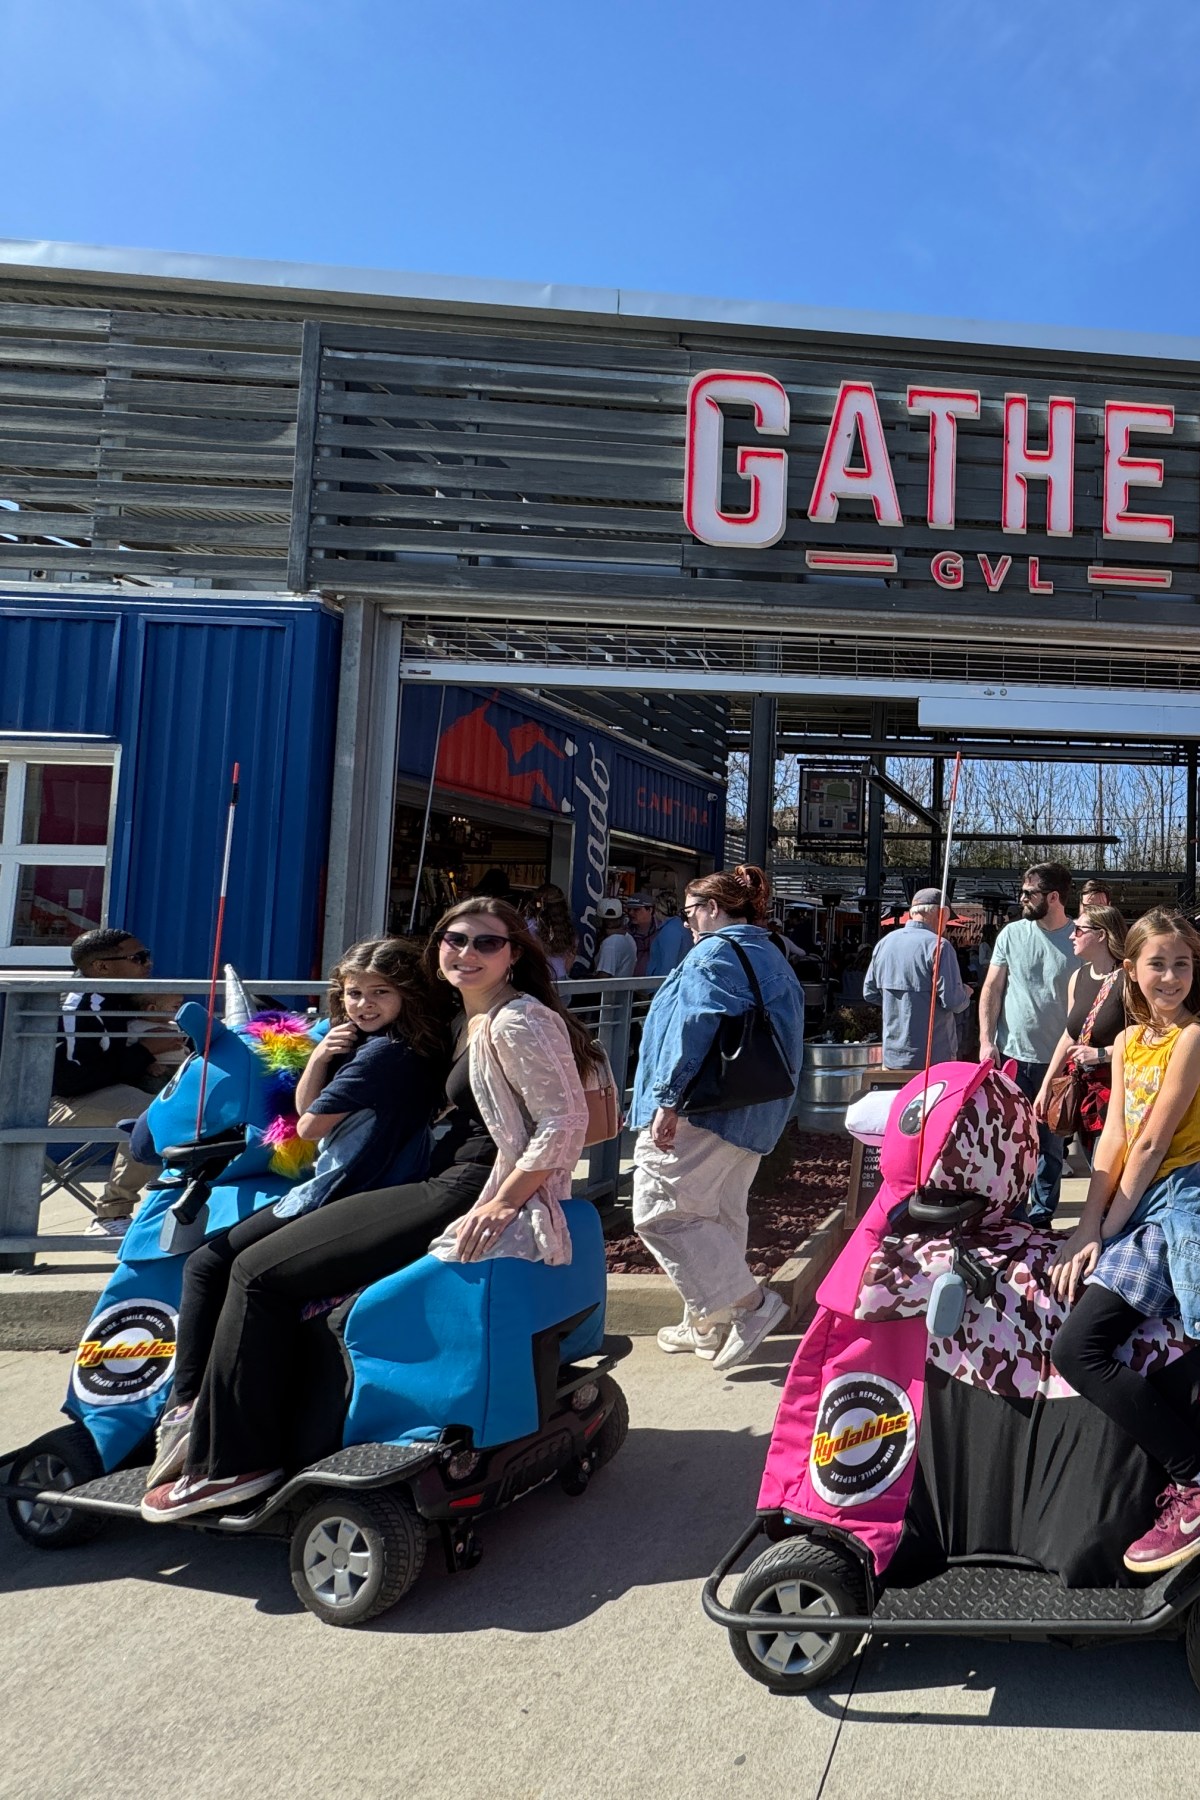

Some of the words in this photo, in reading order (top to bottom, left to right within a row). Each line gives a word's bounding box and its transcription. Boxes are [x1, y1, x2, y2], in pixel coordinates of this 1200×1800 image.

[931, 550, 1054, 594] GVL
[574, 741, 611, 969] ercado
[77, 1339, 177, 1367] Rydables
[833, 1392, 857, 1407] SMILE.
[859, 1390, 885, 1405] REPEAT.
[812, 1413, 910, 1466] Rydables
[830, 1470, 857, 1483] REPEAT.
